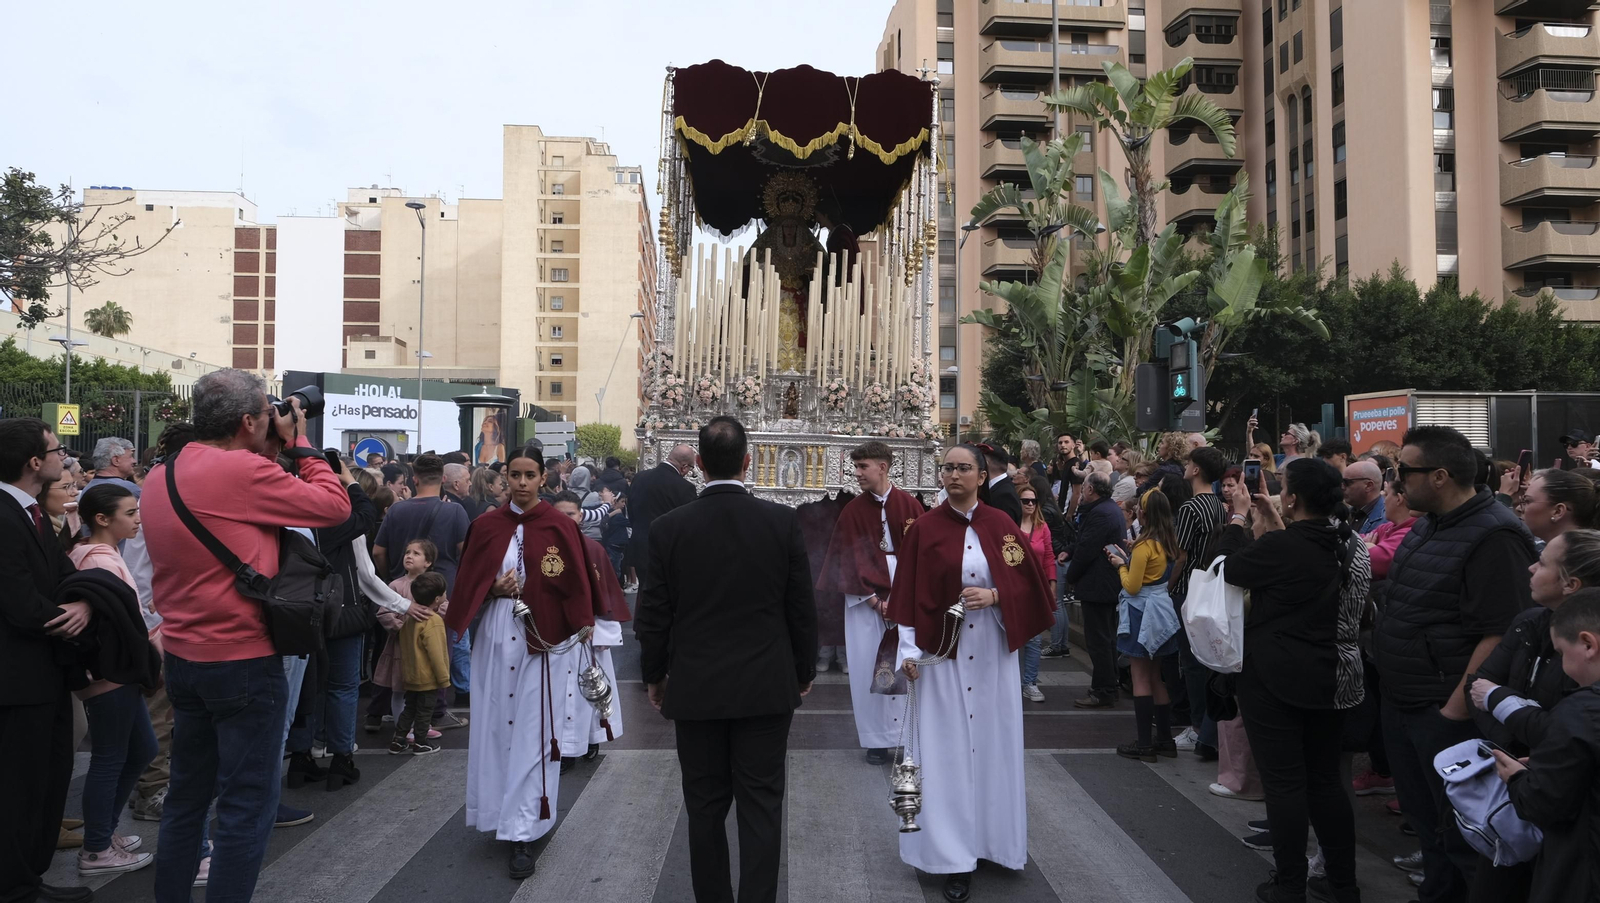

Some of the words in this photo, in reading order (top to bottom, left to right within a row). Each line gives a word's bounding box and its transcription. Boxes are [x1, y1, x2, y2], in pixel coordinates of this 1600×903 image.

[354, 383, 402, 399] ¡HOLA!
[331, 404, 361, 417] ¿Has
[362, 404, 418, 420] pensado
[1353, 409, 1381, 419] Prueeeba
[1382, 407, 1389, 417] el
[1389, 406, 1405, 417] pollo
